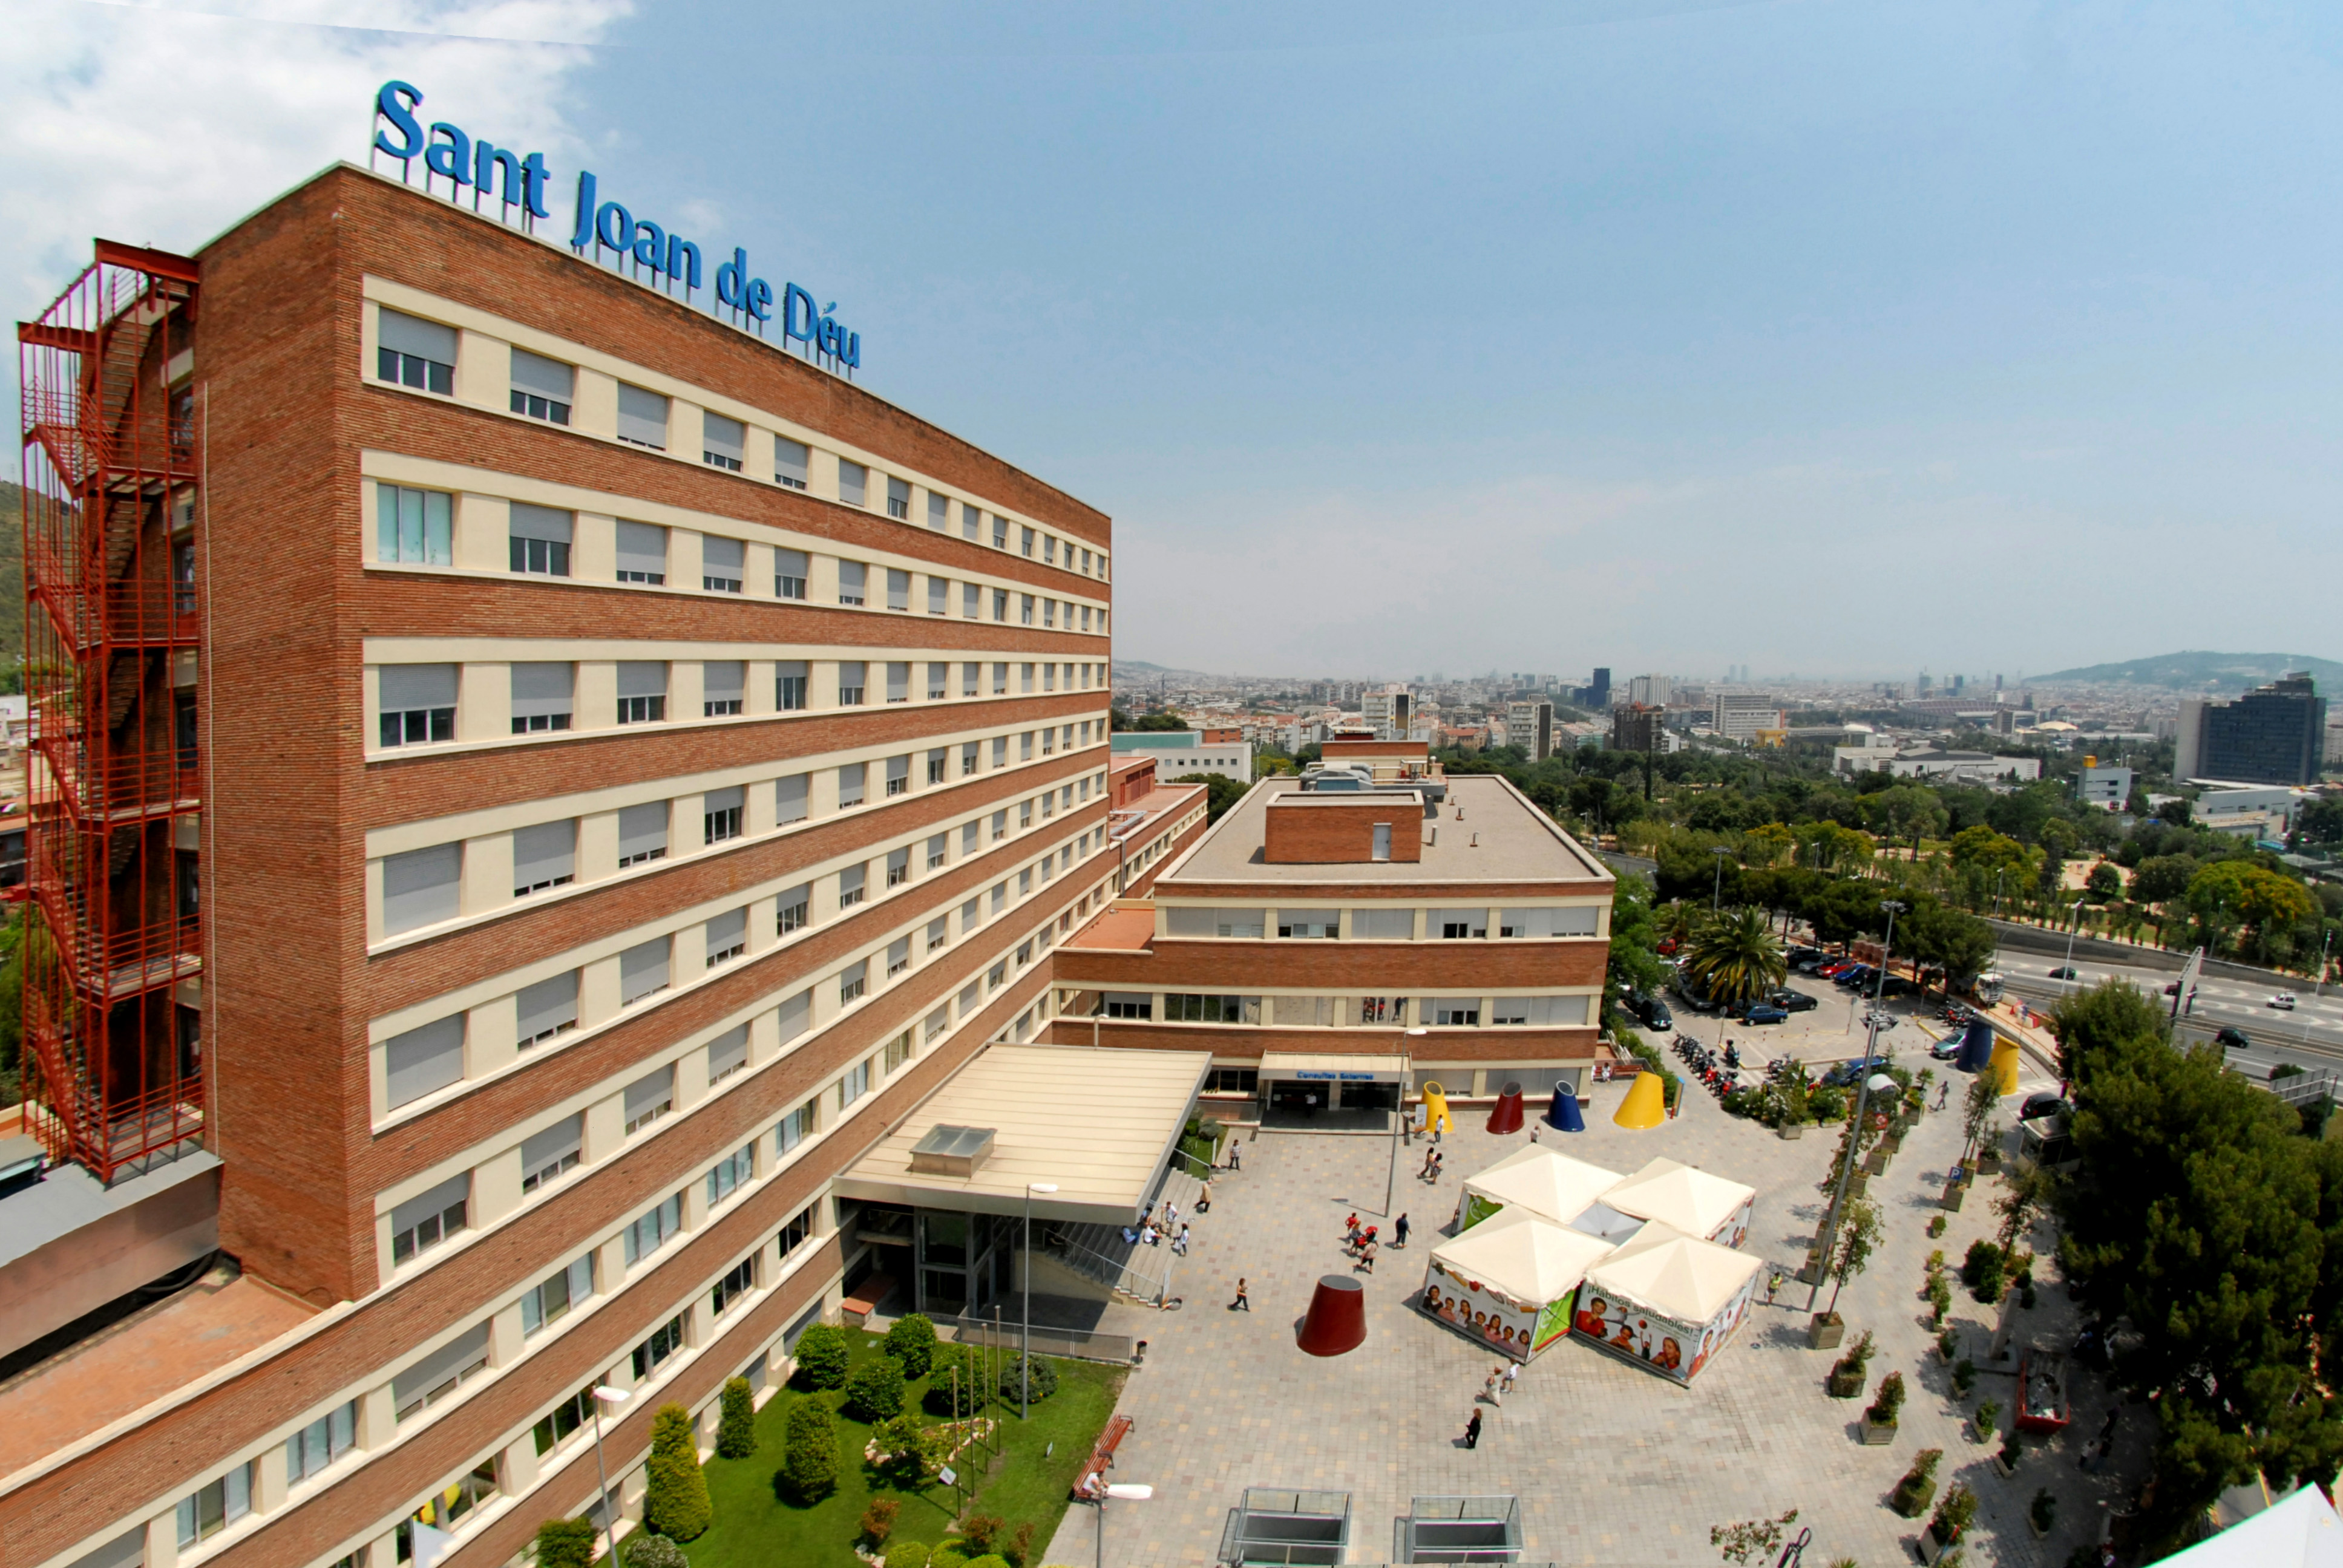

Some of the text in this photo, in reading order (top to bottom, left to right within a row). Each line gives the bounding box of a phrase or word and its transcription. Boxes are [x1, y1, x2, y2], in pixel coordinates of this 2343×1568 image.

[375, 80, 860, 368] Sant Joan de Déu
[1950, 1168, 1960, 1178] P
[1633, 1304, 1694, 1337] saludables!
